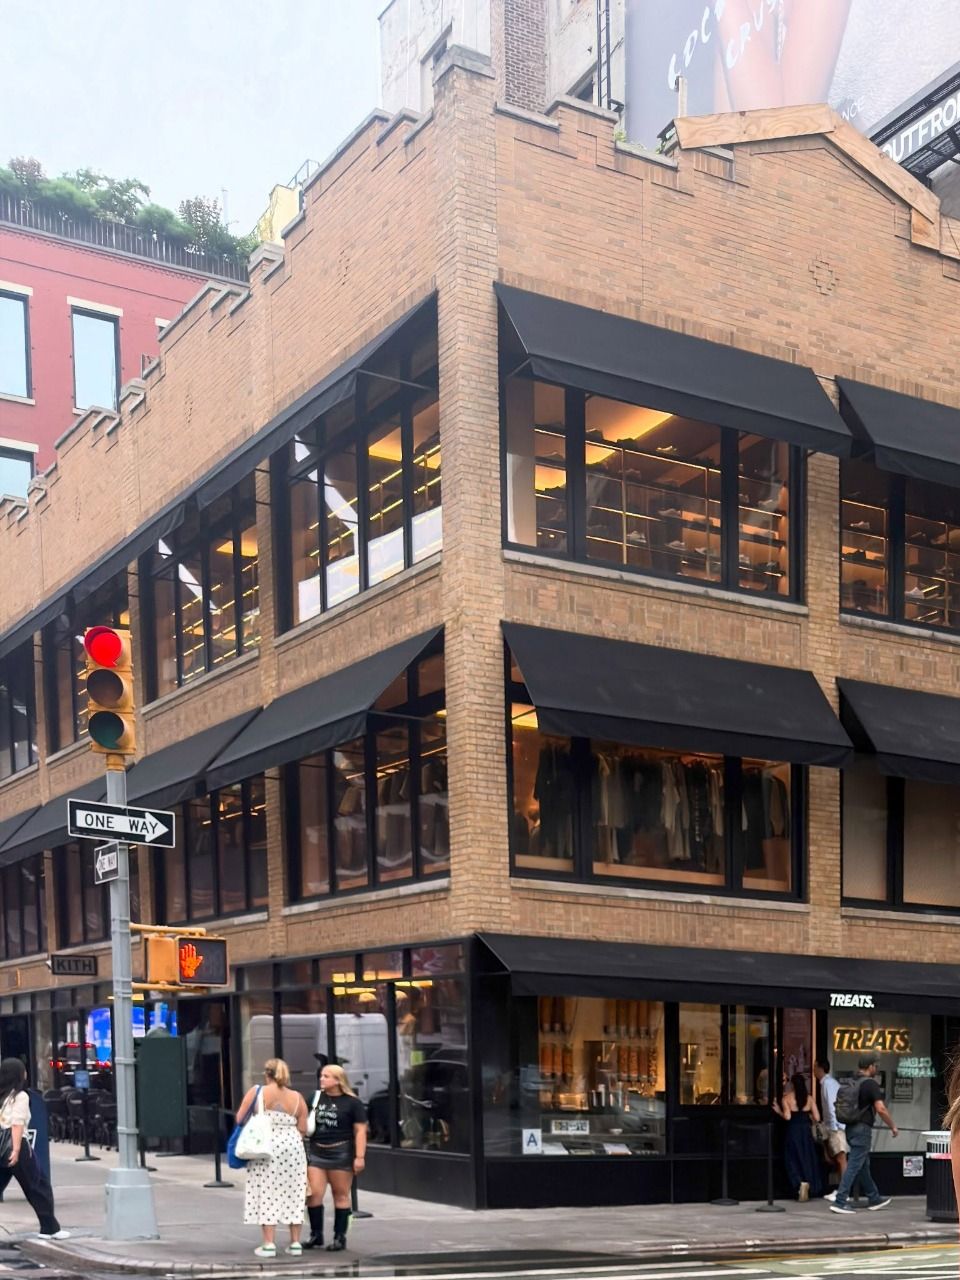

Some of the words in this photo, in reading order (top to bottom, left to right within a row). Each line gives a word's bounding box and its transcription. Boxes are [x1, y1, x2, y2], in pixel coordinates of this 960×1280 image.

[84, 813, 115, 829] ONE
[128, 818, 159, 835] WAY
[56, 959, 92, 971] KITH
[830, 993, 875, 1008] TREATS.
[526, 1132, 538, 1147] A
